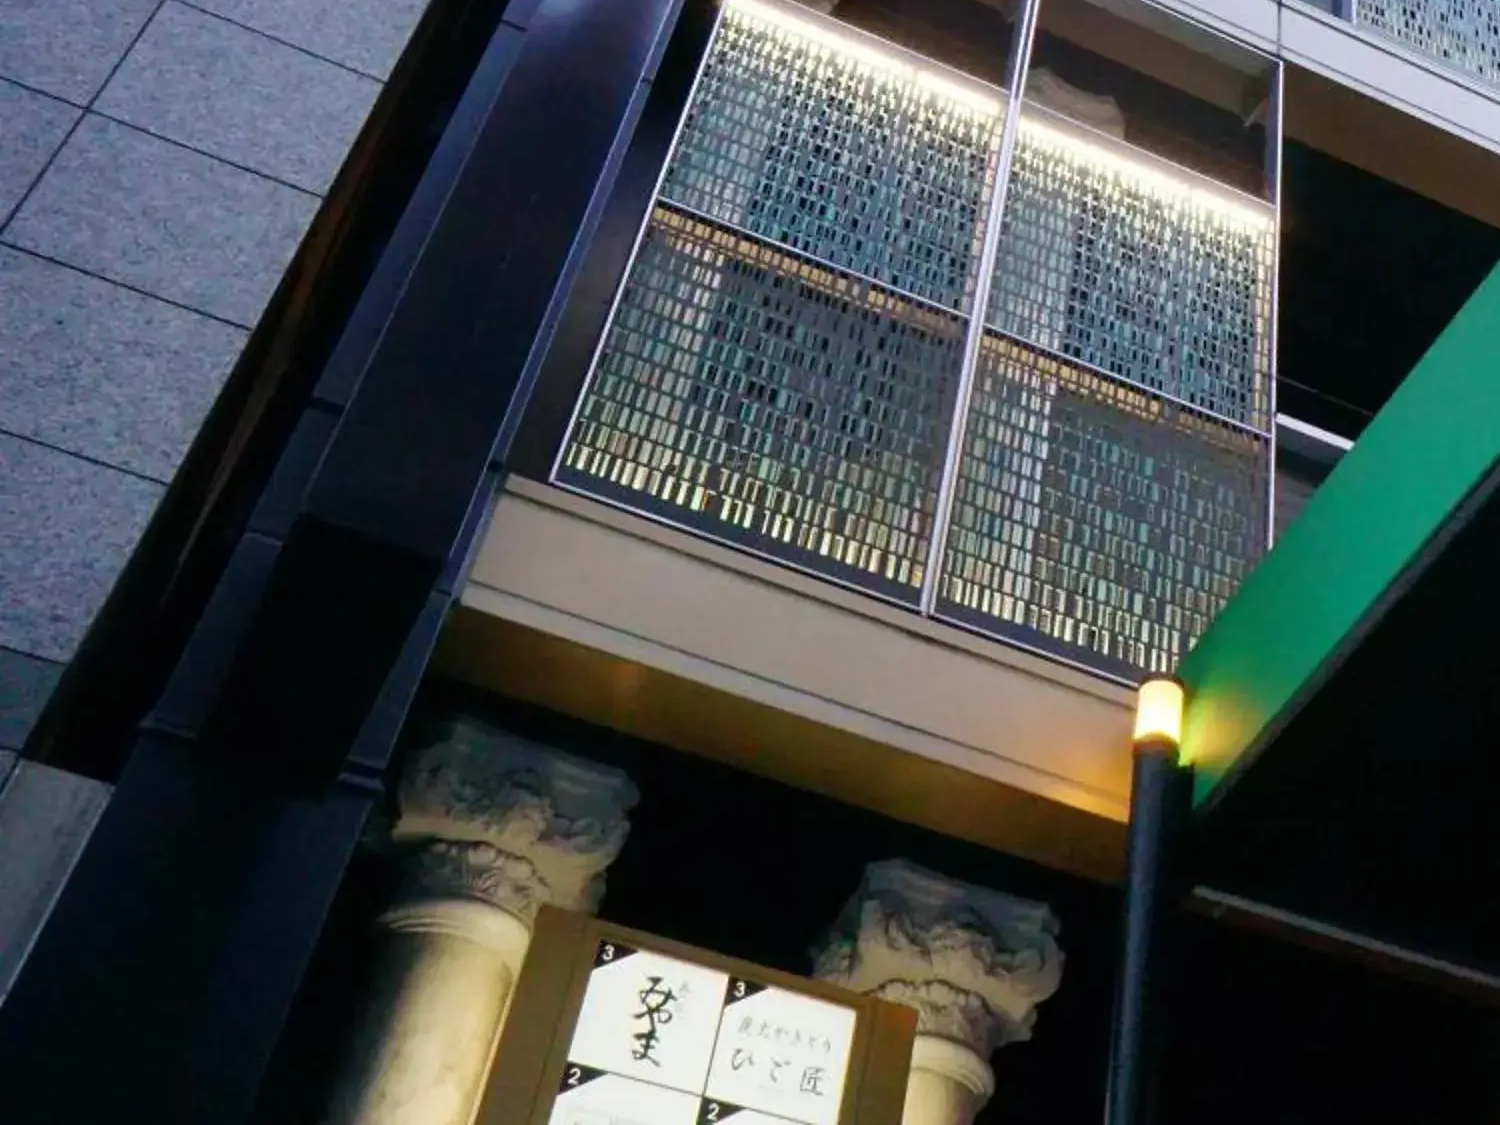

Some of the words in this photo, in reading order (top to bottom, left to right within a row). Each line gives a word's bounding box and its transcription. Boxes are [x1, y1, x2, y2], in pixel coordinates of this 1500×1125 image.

[602, 944, 615, 961] 3
[733, 981, 746, 997] 3
[631, 976, 678, 1068] みやま
[567, 1067, 581, 1085] 2
[707, 1102, 720, 1121] 2
